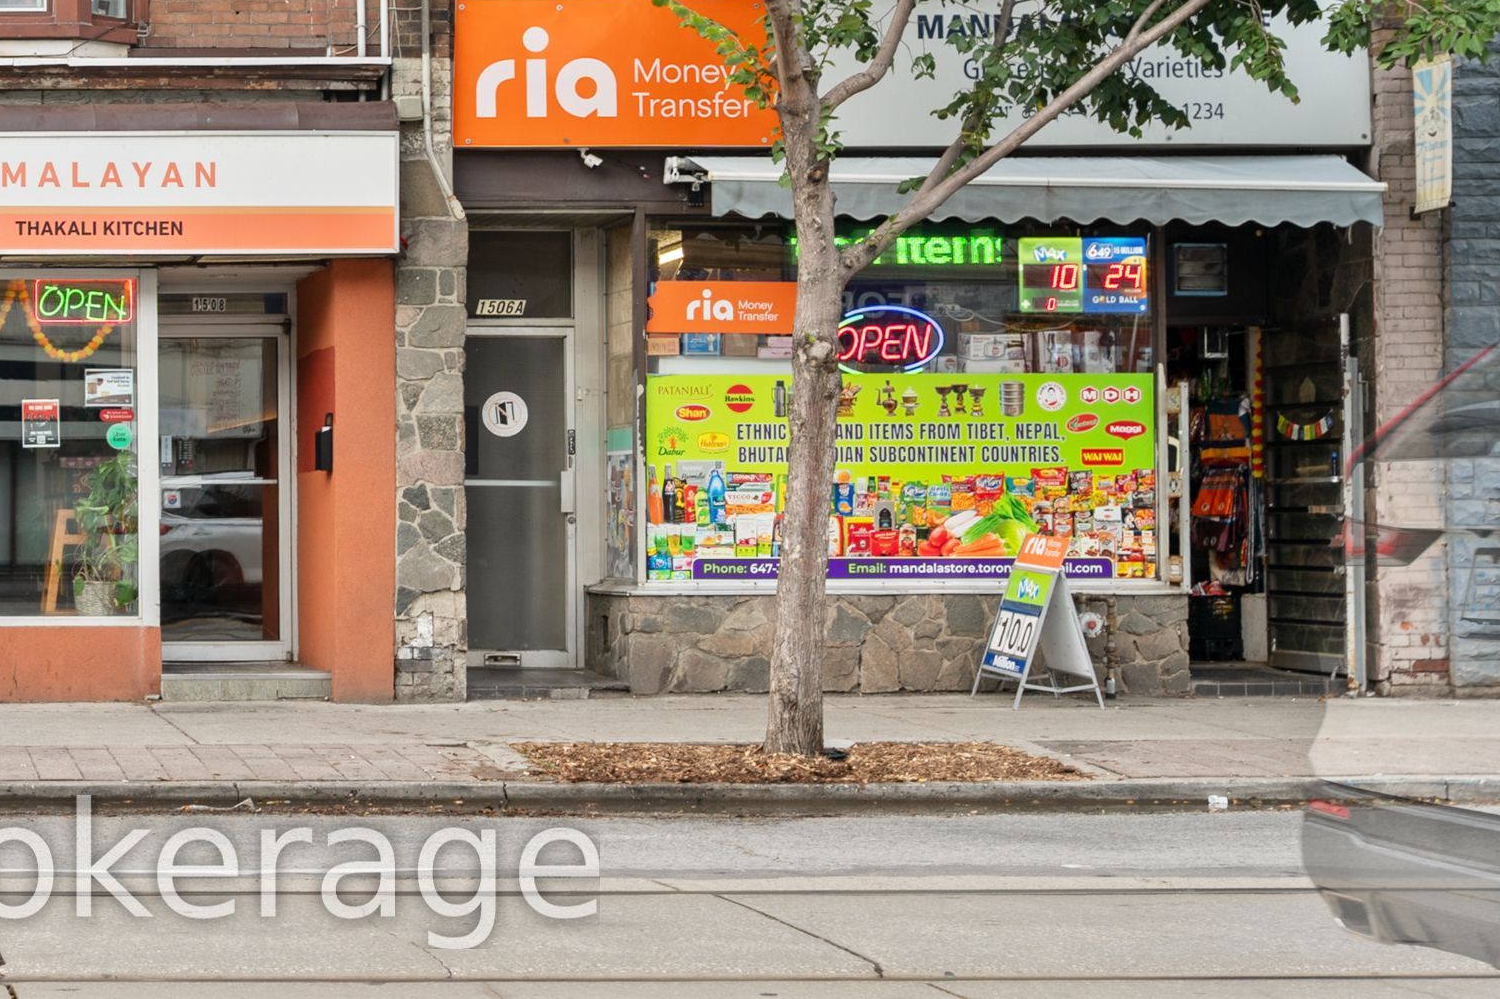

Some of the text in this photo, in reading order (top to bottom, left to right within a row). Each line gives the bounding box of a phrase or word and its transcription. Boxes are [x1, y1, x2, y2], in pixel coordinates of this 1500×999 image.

[475, 25, 618, 118] ria
[633, 57, 737, 90] Money
[1128, 56, 1224, 78] Varieties
[632, 91, 754, 118] Transfer
[15, 220, 98, 238] THAKALI
[102, 220, 183, 238] KITCHEN
[1051, 264, 1079, 289] 10
[1104, 264, 1142, 289] 24
[38, 285, 126, 321] OPEN
[194, 298, 226, 311] 1508
[477, 300, 525, 315] 1506A
[686, 288, 734, 321] ria
[738, 300, 773, 312] Money
[1118, 295, 1139, 304] BALL
[738, 311, 779, 321] Transfer
[837, 324, 934, 362] OPEN
[657, 384, 711, 396] PATANJALI
[724, 395, 756, 403] Hawkins
[677, 407, 707, 419] Shan
[737, 423, 787, 441] ETHNIC
[836, 423, 864, 441] AND
[869, 423, 914, 441] ITEMS
[919, 423, 960, 441] FROM
[966, 423, 1010, 442] TIBET,
[1015, 423, 1066, 442] NEPAL,
[1109, 425, 1143, 434] Maggi
[657, 446, 685, 457] Dabur
[869, 446, 976, 464] SUBCONTINENT
[981, 446, 1064, 464] COUNTRIES.
[1083, 452, 1123, 462] WAI WAI
[703, 562, 748, 574] Phone:
[848, 562, 886, 574] Email:
